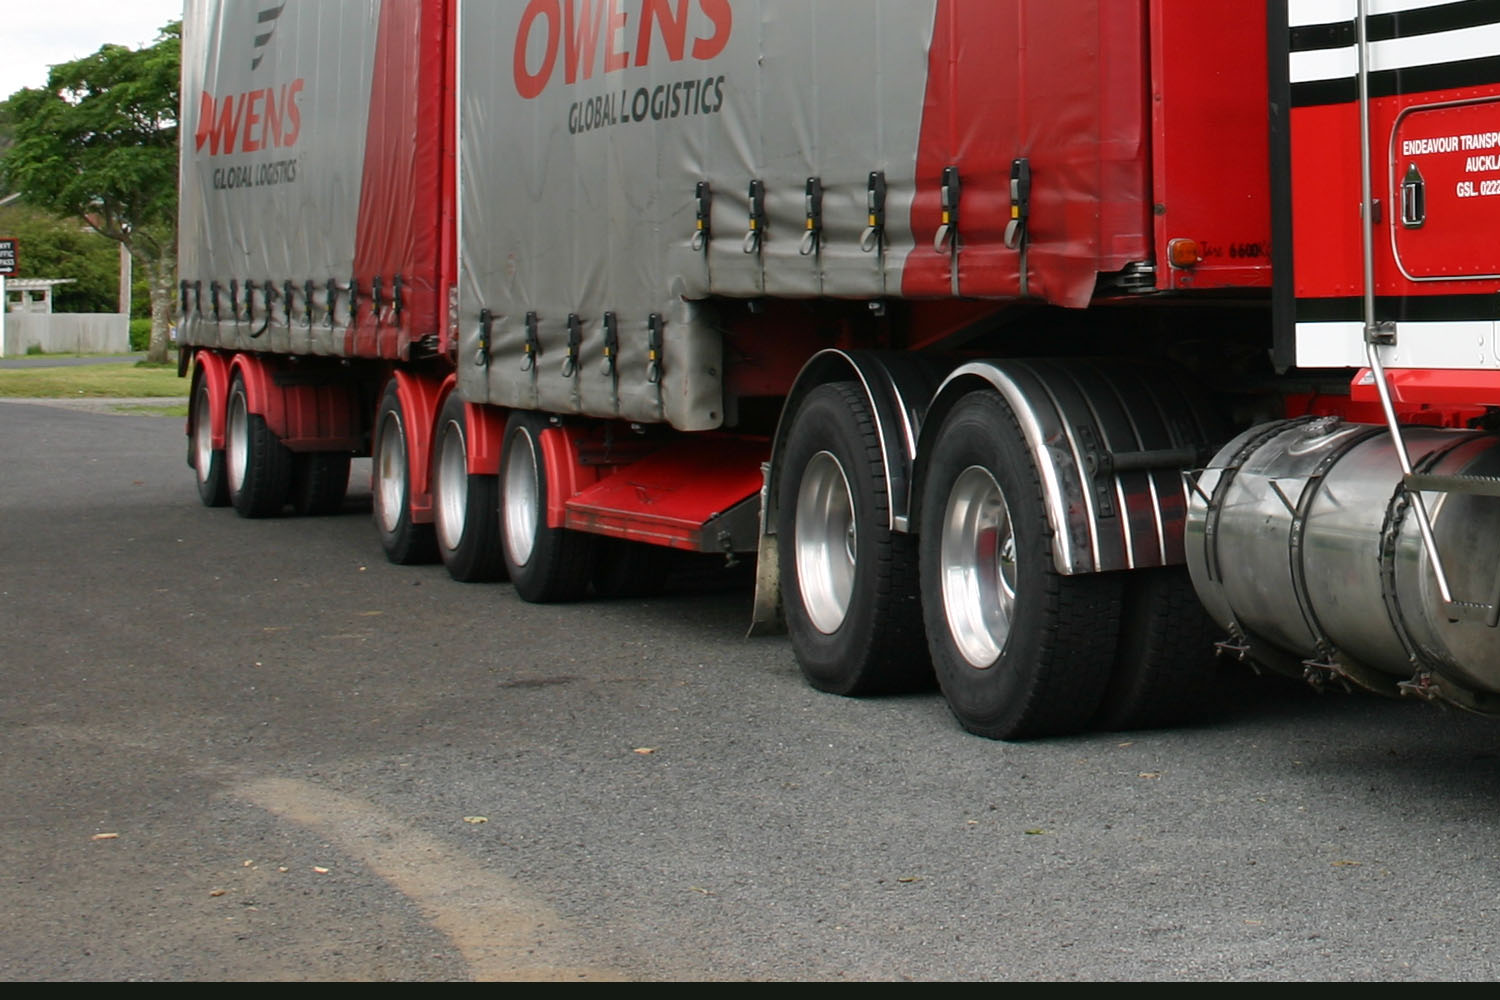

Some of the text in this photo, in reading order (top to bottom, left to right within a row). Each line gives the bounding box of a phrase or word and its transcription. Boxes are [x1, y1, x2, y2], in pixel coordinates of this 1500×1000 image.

[568, 75, 725, 135] GLOBAL LOGISTICS
[1402, 136, 1459, 156] ENDEAVOUR
